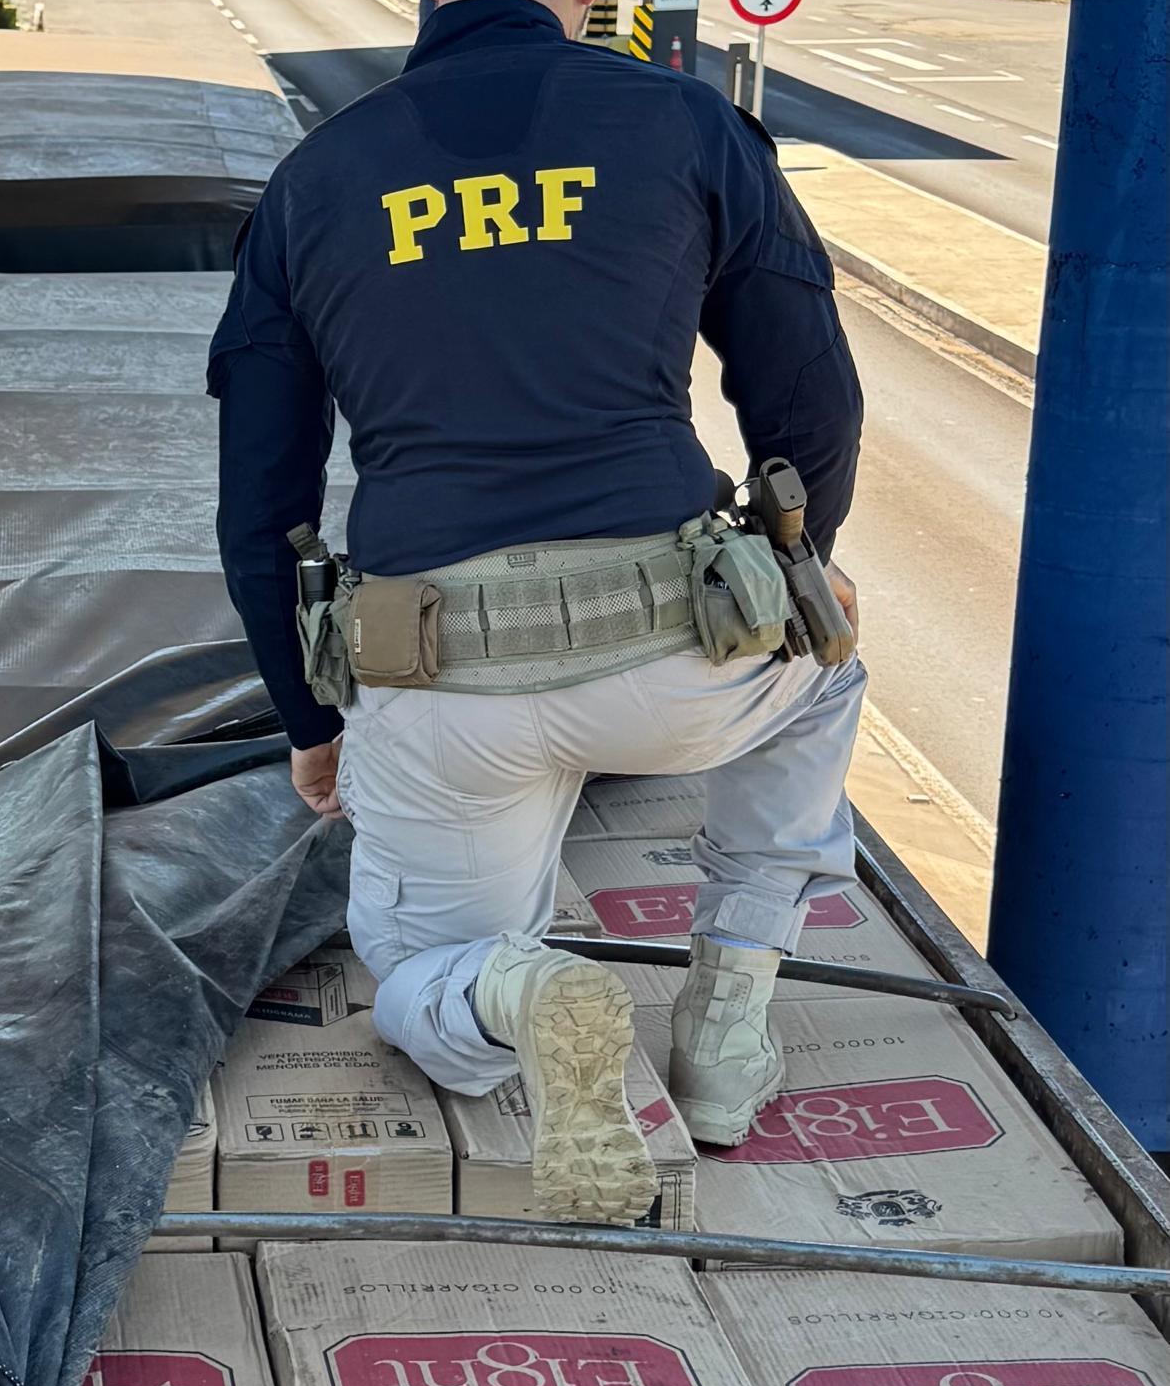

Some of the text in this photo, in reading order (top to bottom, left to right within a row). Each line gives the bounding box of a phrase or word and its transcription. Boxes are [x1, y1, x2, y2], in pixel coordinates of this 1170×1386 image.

[381, 166, 595, 265] PRF
[259, 1052, 300, 1060] VENTA
[256, 1062, 320, 1071] MENORES
[750, 1097, 961, 1148] Eigh
[343, 1282, 616, 1295] 10 000 CIGARRILLOS
[787, 1310, 967, 1325] CIGARRILLOS
